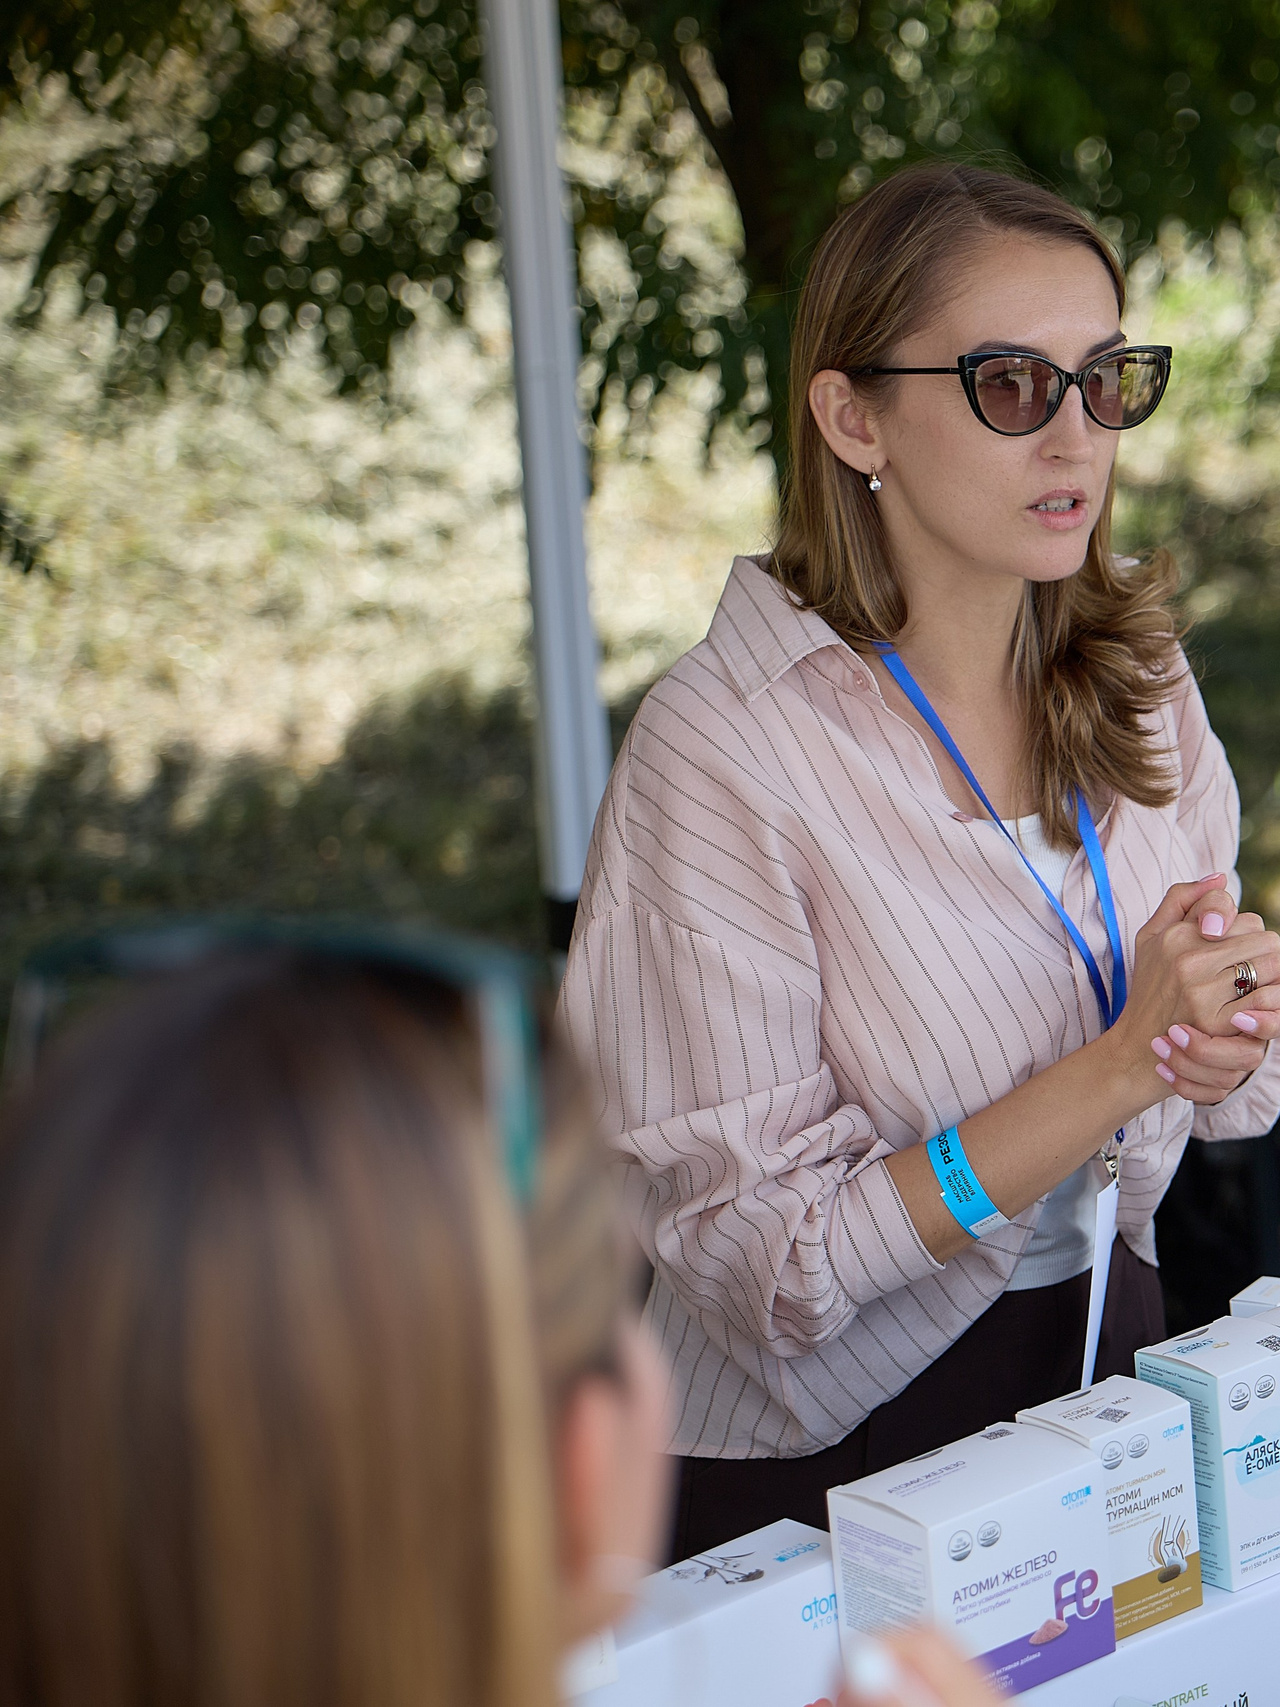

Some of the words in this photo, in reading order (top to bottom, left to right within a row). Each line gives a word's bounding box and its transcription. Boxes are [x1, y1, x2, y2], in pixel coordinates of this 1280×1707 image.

[937, 1131, 954, 1165] РЕЗО
[945, 1175, 963, 1203] МАСШТАБ
[951, 1169, 971, 1202] ЛИДЕРСТВО
[923, 1460, 966, 1479] ЖЕЛЕЗО
[1153, 1468, 1166, 1478] MSM
[1105, 1487, 1141, 1509] АТОМИ
[1106, 1494, 1160, 1522] ТУРМАЦИН
[1161, 1483, 1183, 1501] МСМ
[952, 1575, 1000, 1605] АТОМИ
[1002, 1550, 1058, 1584] ЖЕЛЕЗО
[801, 1593, 838, 1622] atom
[955, 1601, 977, 1615] Легко
[1020, 1574, 1044, 1587] железо
[1053, 1569, 1101, 1621] Fe
[812, 1612, 838, 1631] ATO
[955, 1610, 979, 1625] вкусом
[979, 1597, 1011, 1618] голубики
